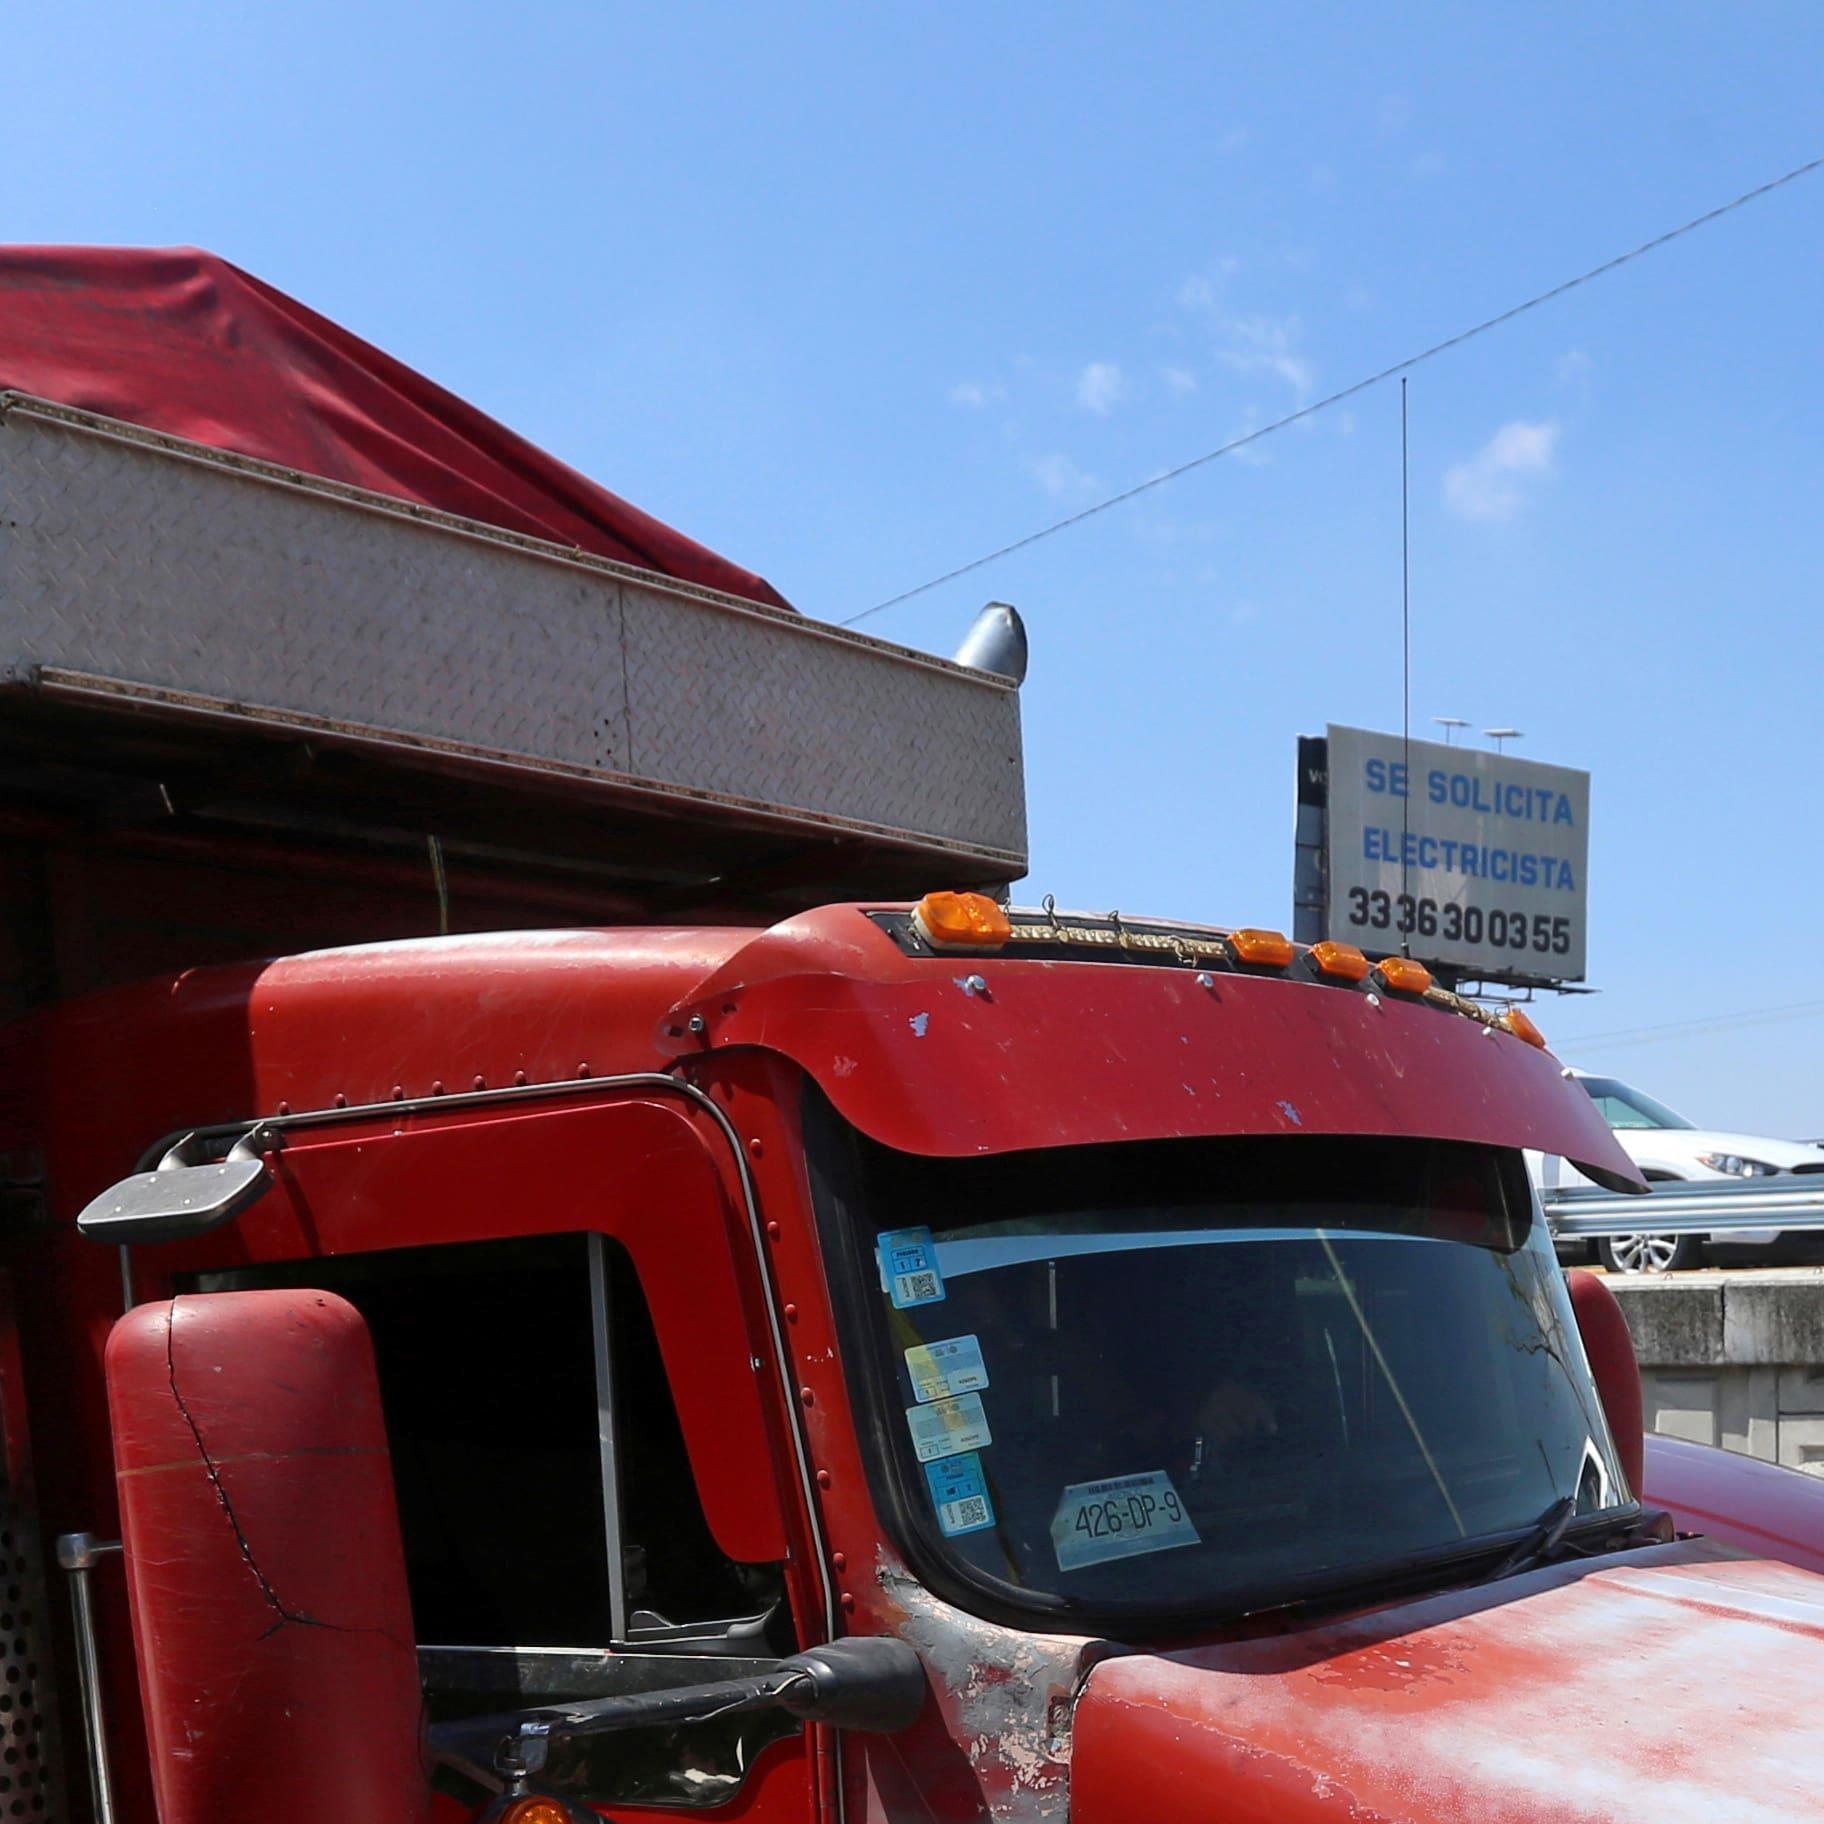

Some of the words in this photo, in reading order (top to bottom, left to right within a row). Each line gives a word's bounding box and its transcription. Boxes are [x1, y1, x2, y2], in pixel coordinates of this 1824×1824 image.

[1365, 759, 1409, 797] SE
[1428, 770, 1574, 827] SOLICITA
[1363, 826, 1575, 891] ELECTRICISTA
[1075, 1491, 1182, 1538] 426-DP-9
